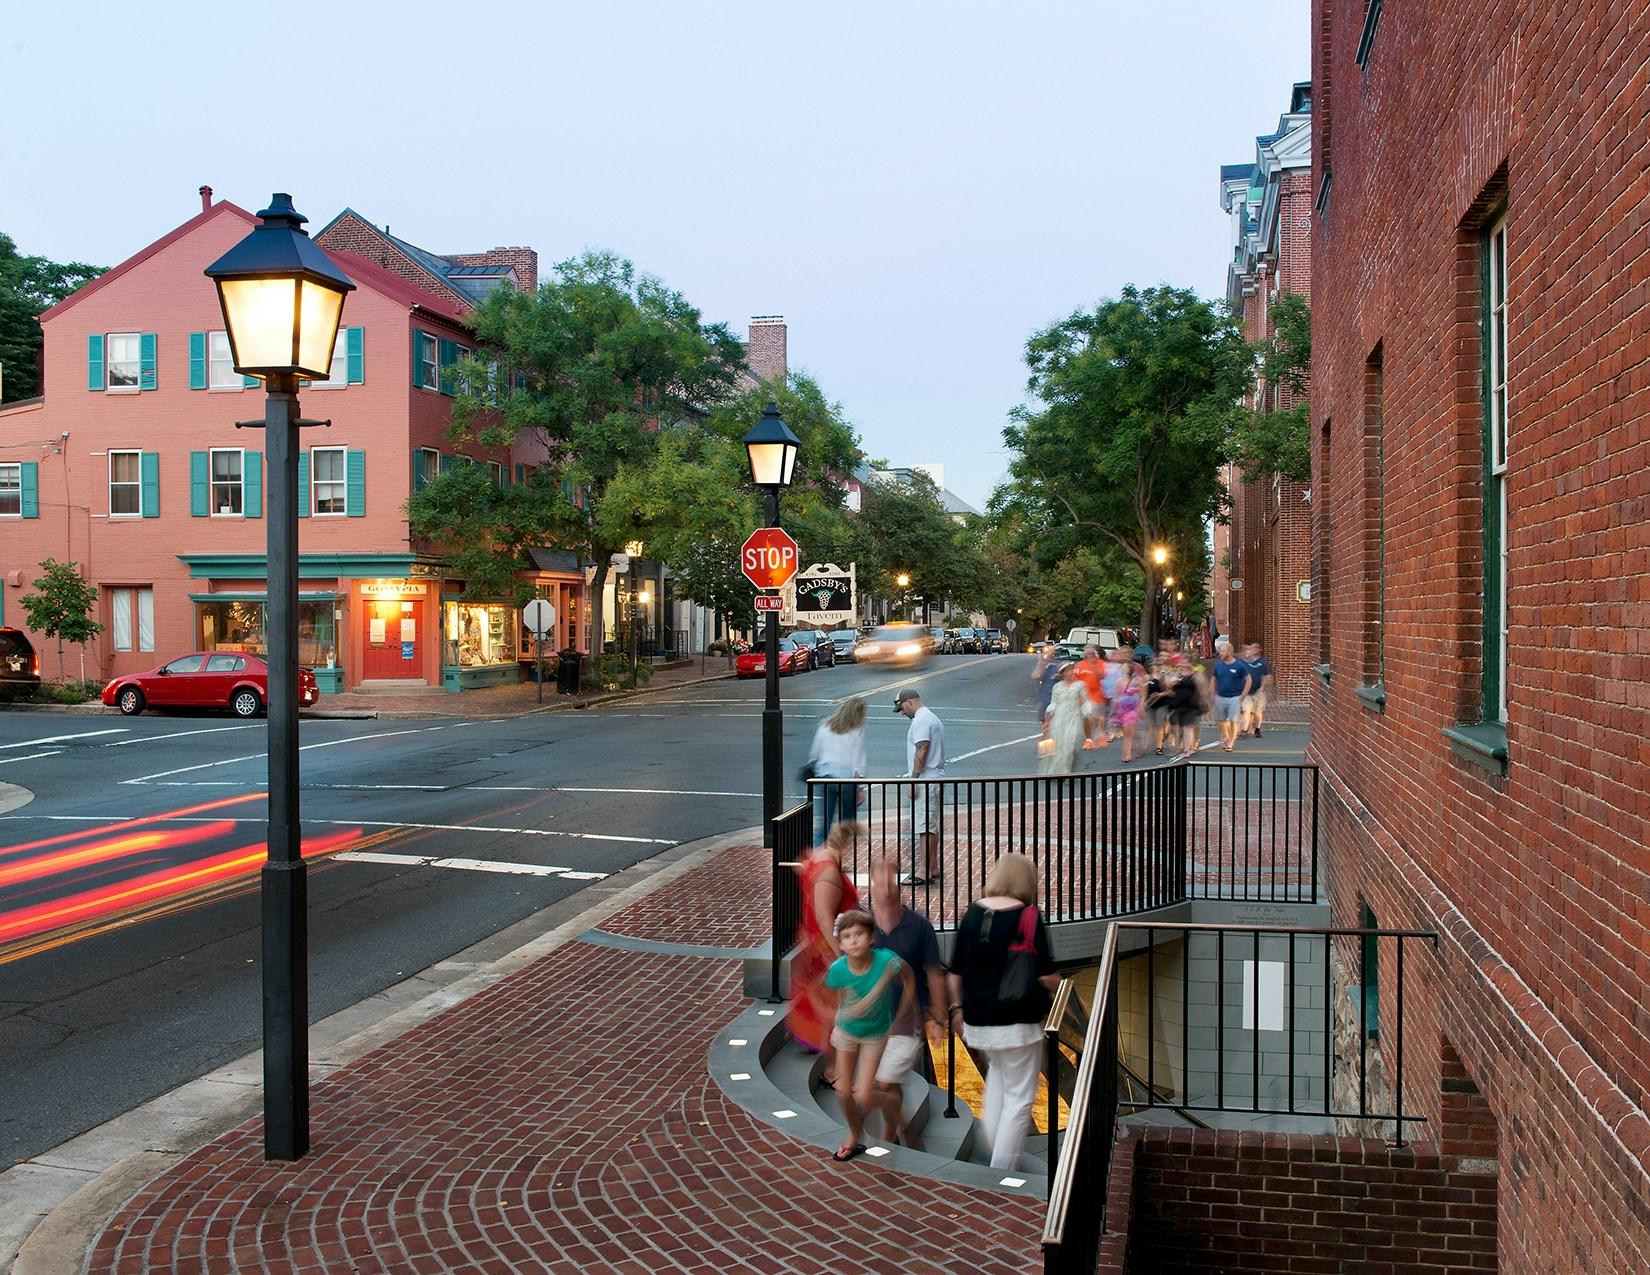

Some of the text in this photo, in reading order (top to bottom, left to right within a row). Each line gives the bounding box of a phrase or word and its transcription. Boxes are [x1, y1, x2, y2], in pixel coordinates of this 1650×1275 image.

[746, 547, 793, 569] STOP
[798, 578, 848, 594] GADSBY'S
[756, 599, 782, 608] ALL WAY
